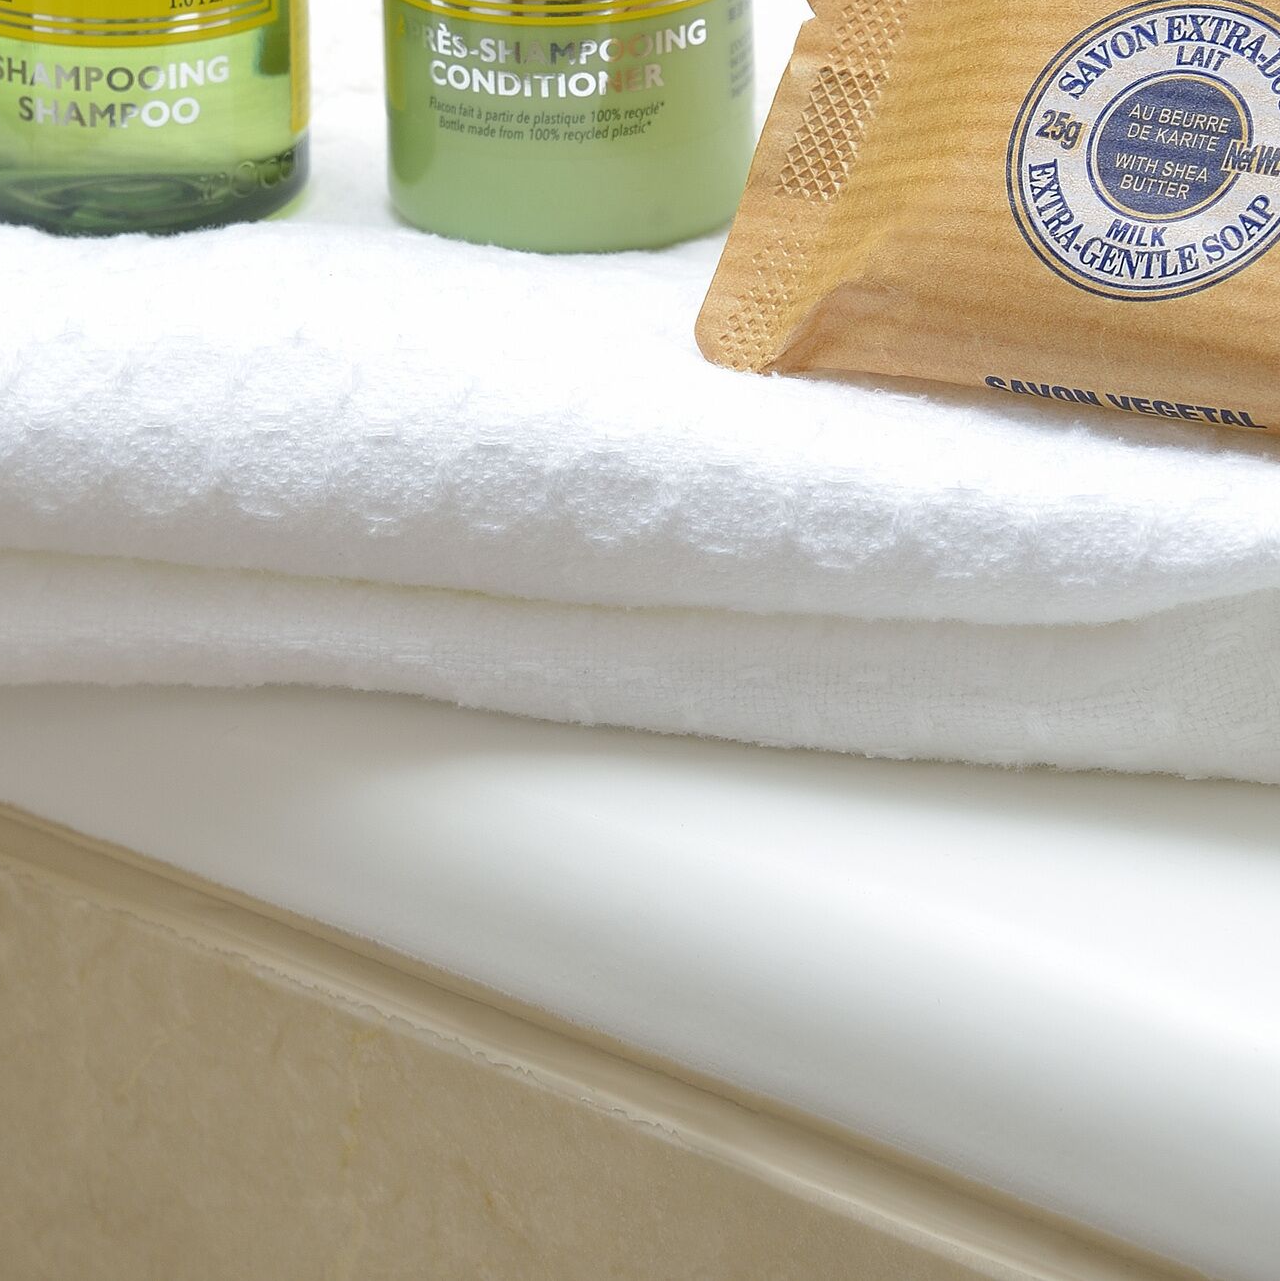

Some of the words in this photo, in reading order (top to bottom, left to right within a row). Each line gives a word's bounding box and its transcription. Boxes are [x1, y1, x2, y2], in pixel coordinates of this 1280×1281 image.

[1058, 19, 1159, 100] SAVON
[1176, 46, 1231, 72] LAIT
[429, 60, 665, 98] CONDITIONER
[18, 96, 201, 128] SHAMPOO
[459, 103, 475, 119] fait
[485, 110, 514, 124] partir
[516, 111, 531, 124] de
[533, 111, 586, 127] plastique
[591, 108, 621, 123] 100%
[1128, 103, 1155, 122] AU
[1159, 109, 1231, 134] BEURRE
[439, 116, 465, 133] Bottle
[467, 124, 497, 138] made
[499, 125, 524, 140] from
[529, 128, 560, 141] 100%
[563, 125, 610, 144] recycled
[1035, 109, 1083, 150] 25g
[1127, 123, 1154, 139] DE
[1155, 127, 1221, 152] KARITE
[1116, 152, 1157, 174] WITH
[1162, 159, 1209, 183] SHEA
[1224, 140, 1258, 172] Net
[1120, 174, 1191, 200] BUTTER
[1027, 158, 1200, 280] EXTRA-GENTLE
[1202, 193, 1276, 265] SOAP
[1105, 218, 1168, 248] MILK
[1105, 393, 1268, 429] VEGETAL
